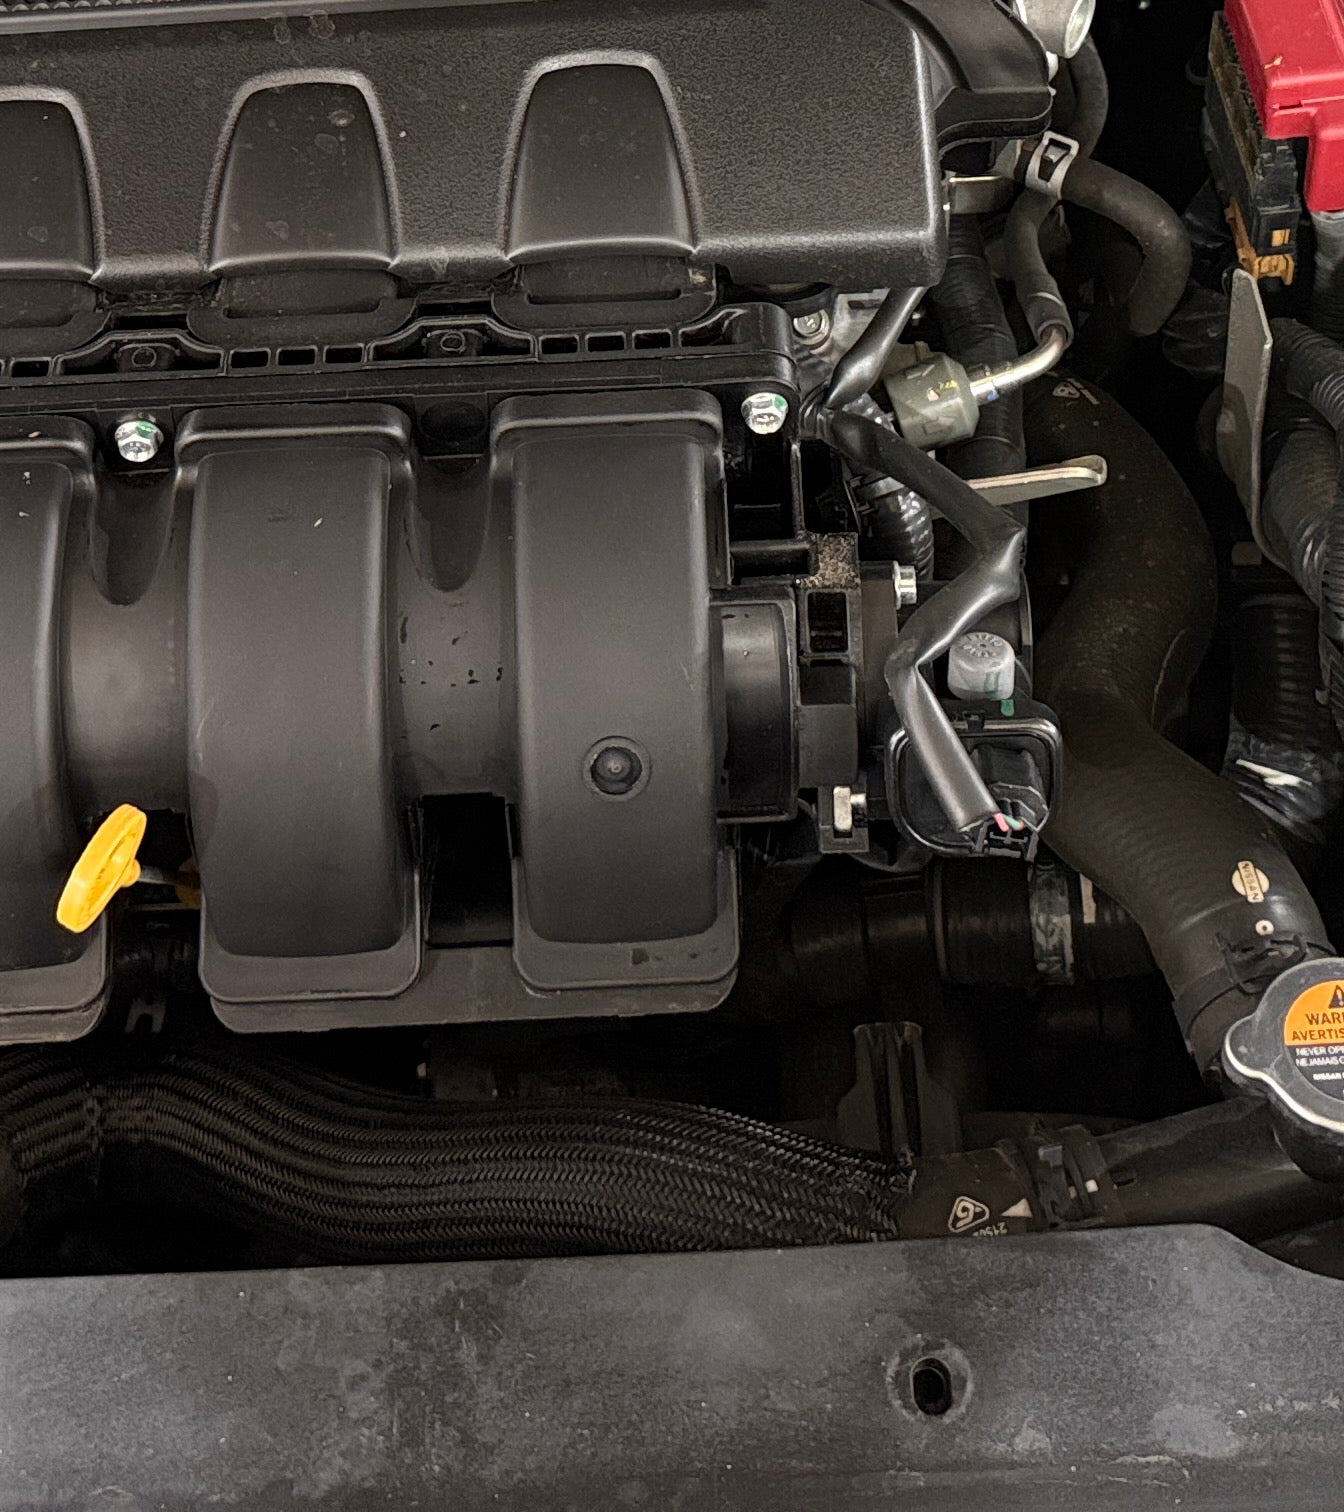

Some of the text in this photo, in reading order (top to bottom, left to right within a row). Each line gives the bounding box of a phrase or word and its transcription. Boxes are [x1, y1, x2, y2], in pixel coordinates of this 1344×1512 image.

[1241, 862, 1260, 901] NISSAN
[1296, 1046, 1326, 1056] NEVER
[1296, 1057, 1307, 1067] NE
[1307, 1056, 1340, 1066] JAMAIS
[1313, 1072, 1341, 1081] NISSAN
